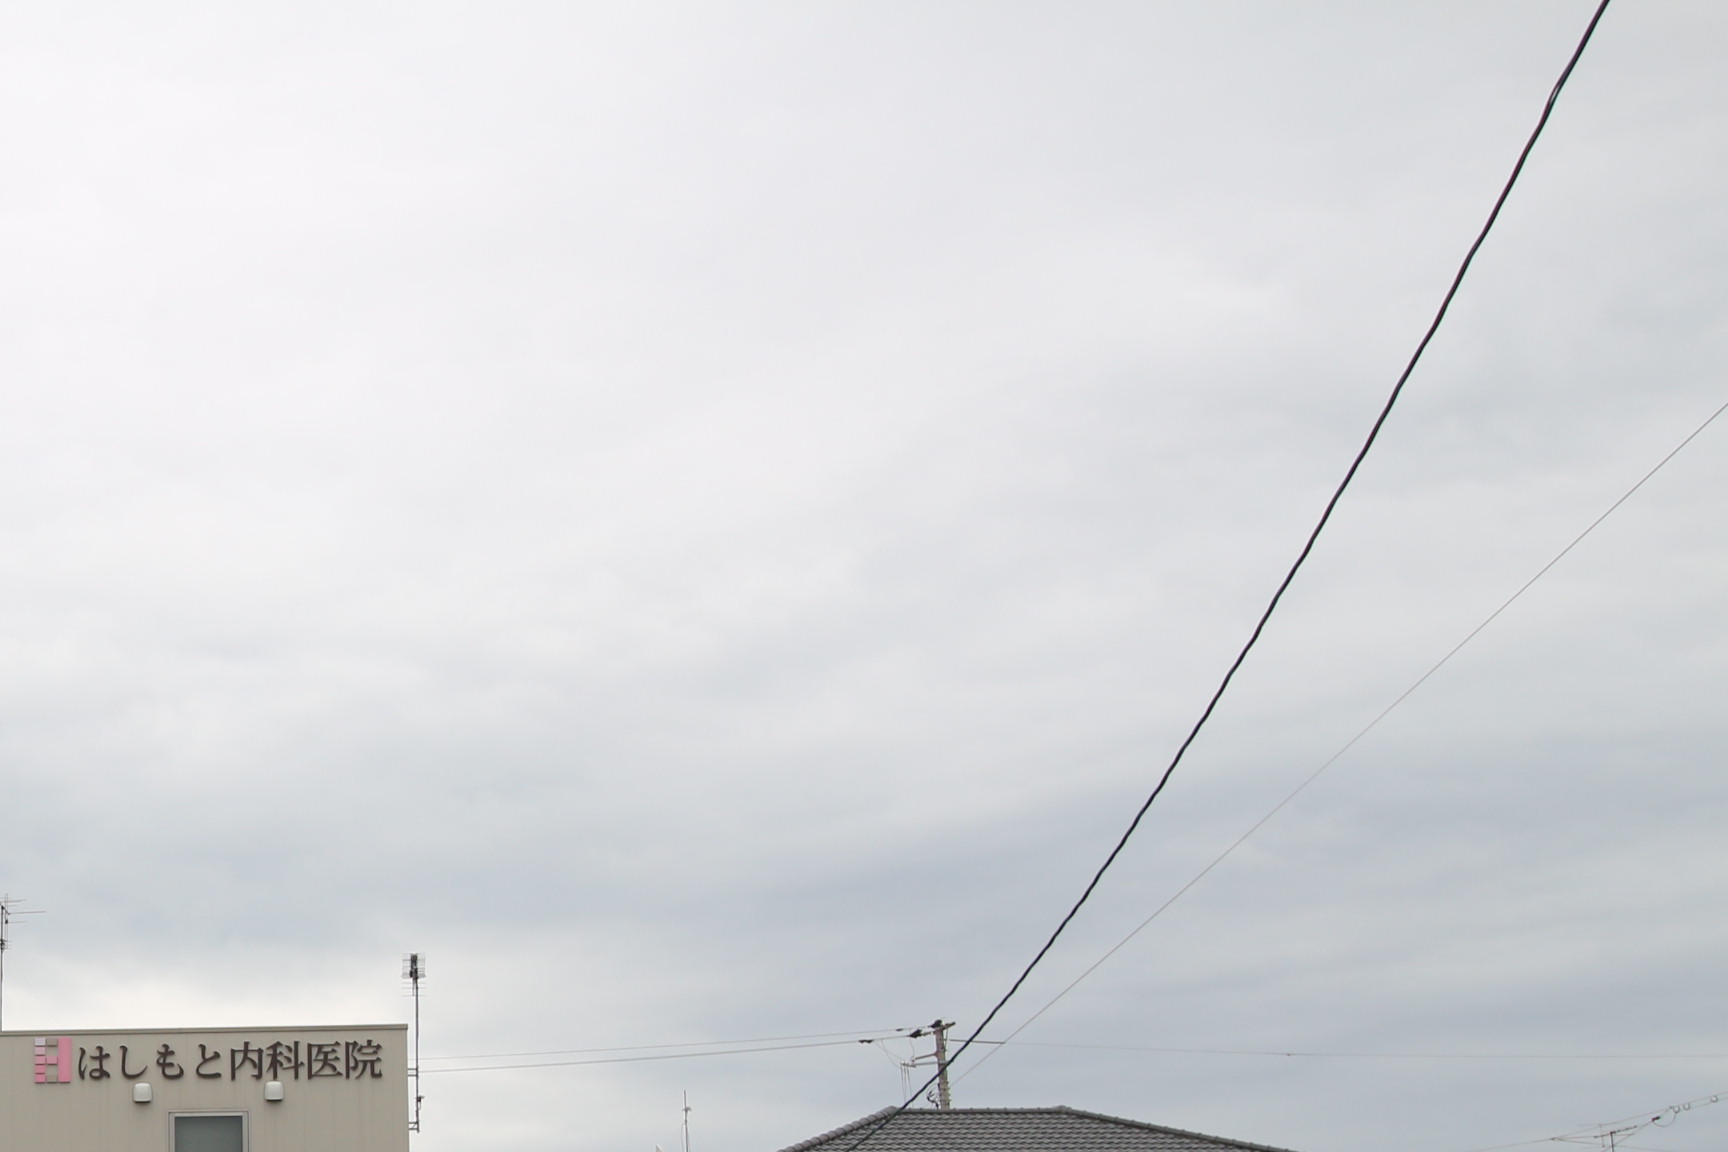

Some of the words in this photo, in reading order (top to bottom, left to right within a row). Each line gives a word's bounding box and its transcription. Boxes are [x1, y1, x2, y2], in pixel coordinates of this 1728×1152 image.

[77, 1038, 384, 1081] はしもと内科医院
